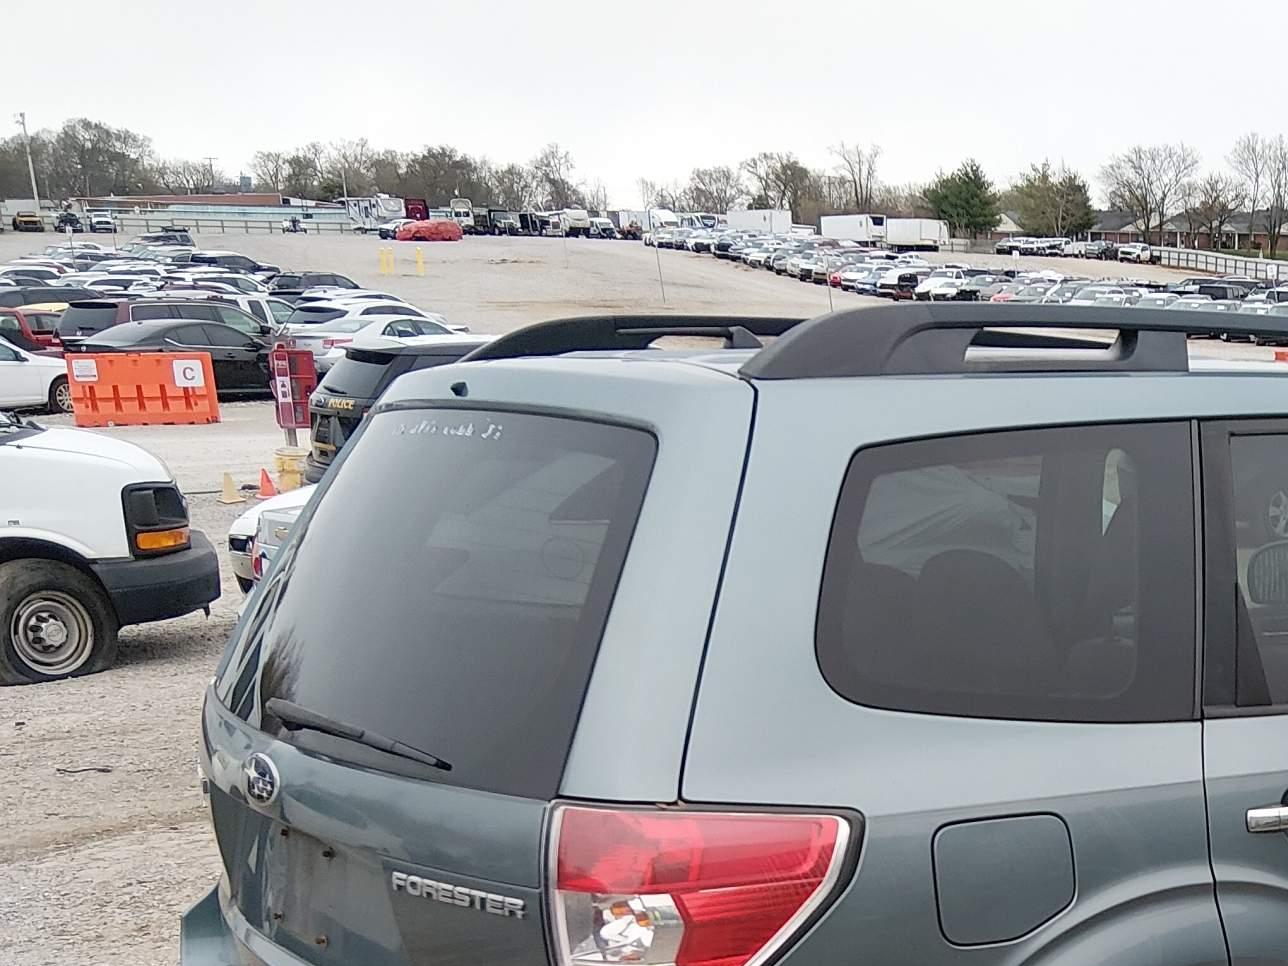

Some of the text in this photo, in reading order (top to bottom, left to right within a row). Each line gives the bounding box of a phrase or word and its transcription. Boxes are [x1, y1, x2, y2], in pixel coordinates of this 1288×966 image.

[182, 366, 195, 381] C
[327, 398, 356, 410] POLICE
[391, 870, 528, 920] FORESTER
